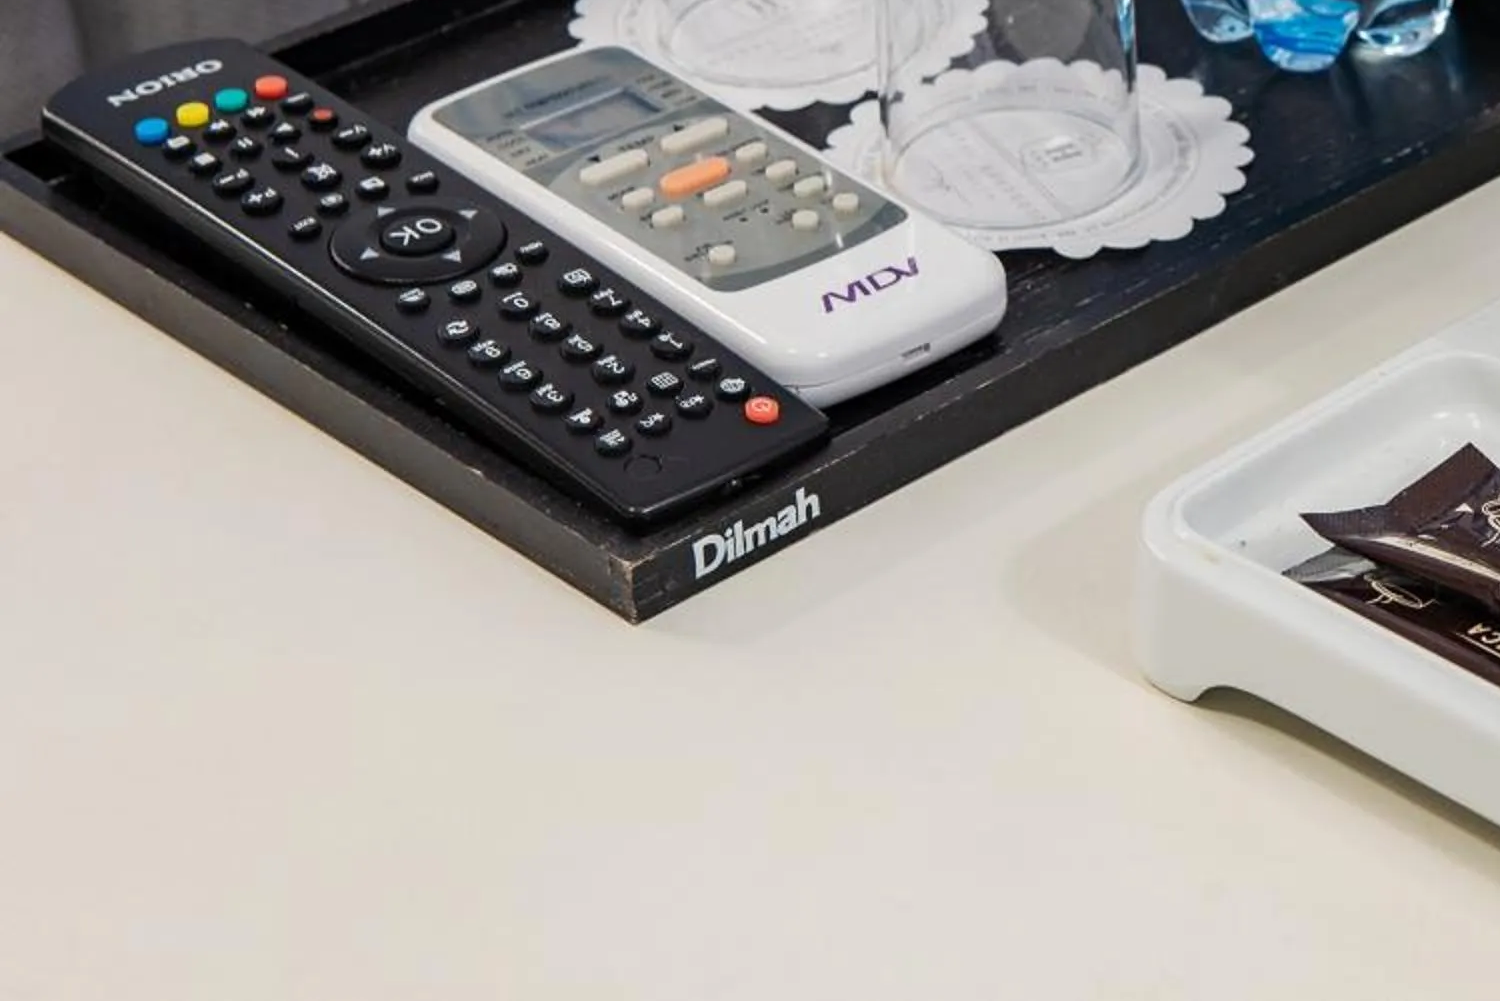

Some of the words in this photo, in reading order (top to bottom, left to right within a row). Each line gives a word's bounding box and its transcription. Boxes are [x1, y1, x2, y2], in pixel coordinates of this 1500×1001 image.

[106, 59, 224, 108] ORION
[389, 217, 443, 247] OK
[822, 256, 920, 314] MDV
[692, 487, 821, 580] Dilmah
